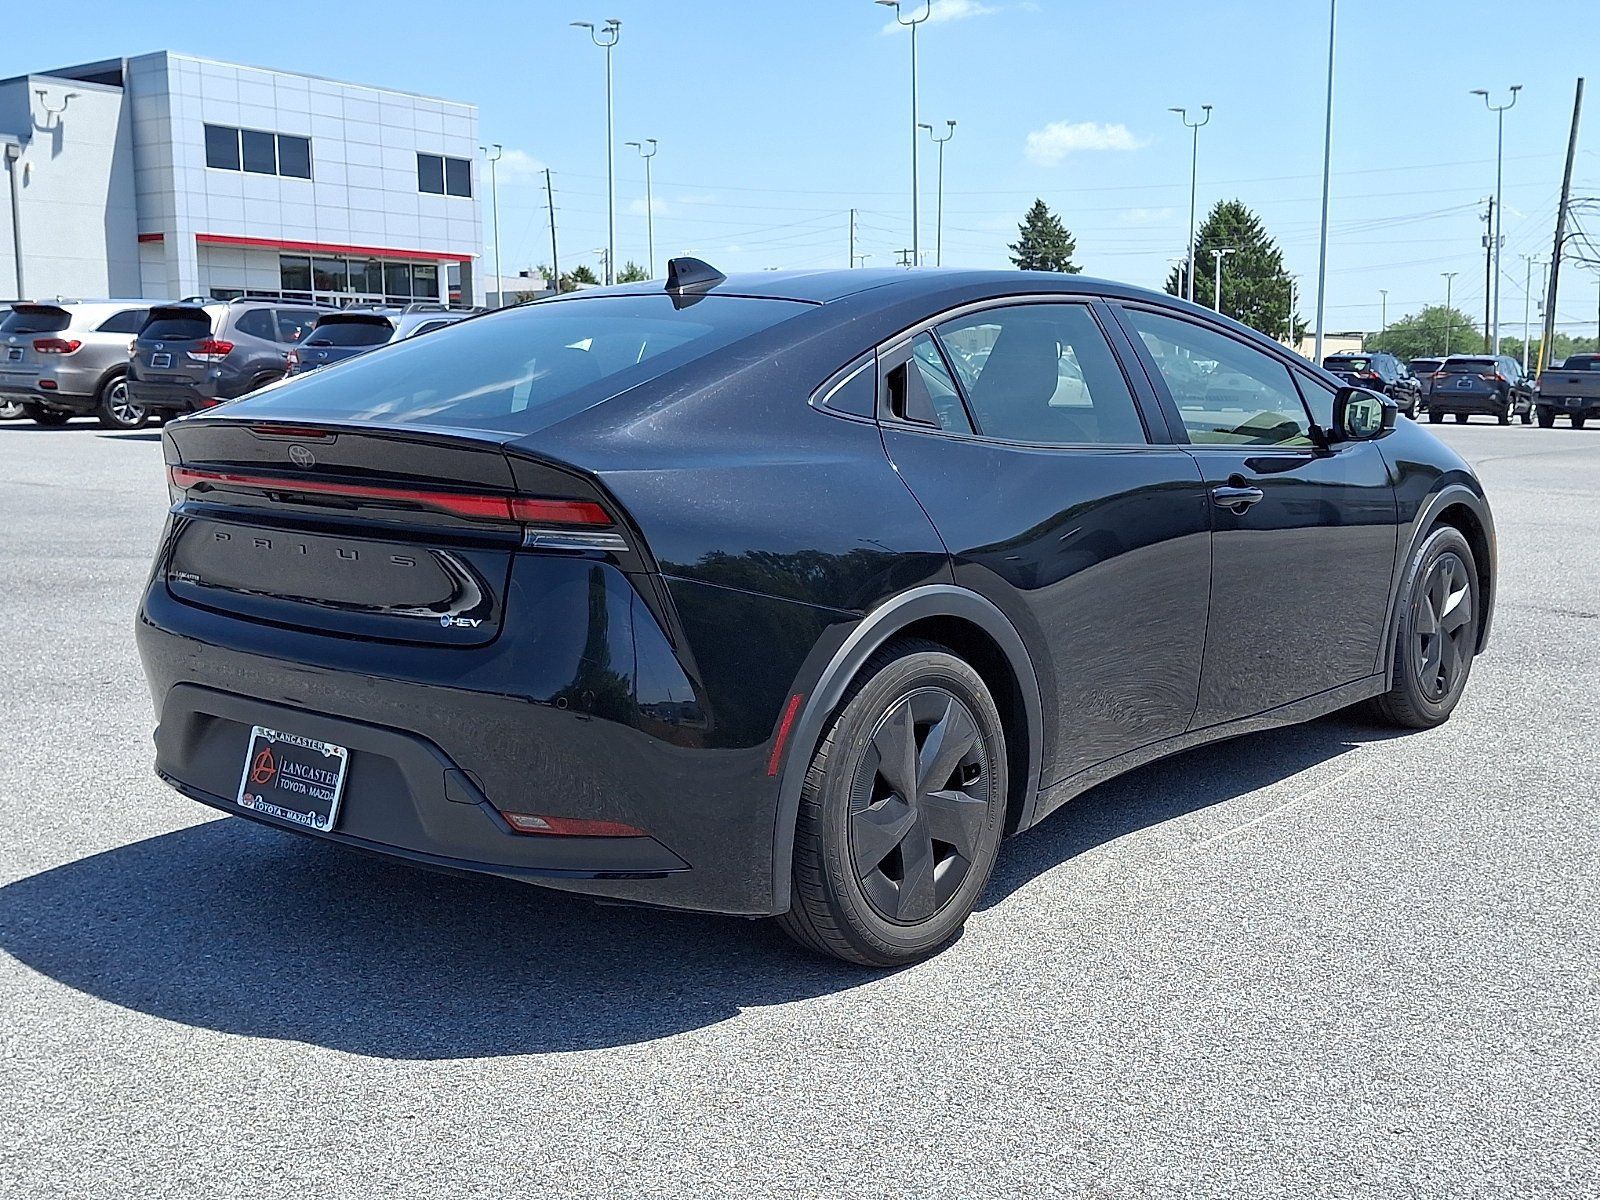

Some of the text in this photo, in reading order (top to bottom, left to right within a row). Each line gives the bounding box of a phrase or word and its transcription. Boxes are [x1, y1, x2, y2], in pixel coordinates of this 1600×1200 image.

[214, 531, 416, 568] PRIUS
[275, 731, 323, 750] LANCASTER
[282, 760, 338, 785] LANCASTER
